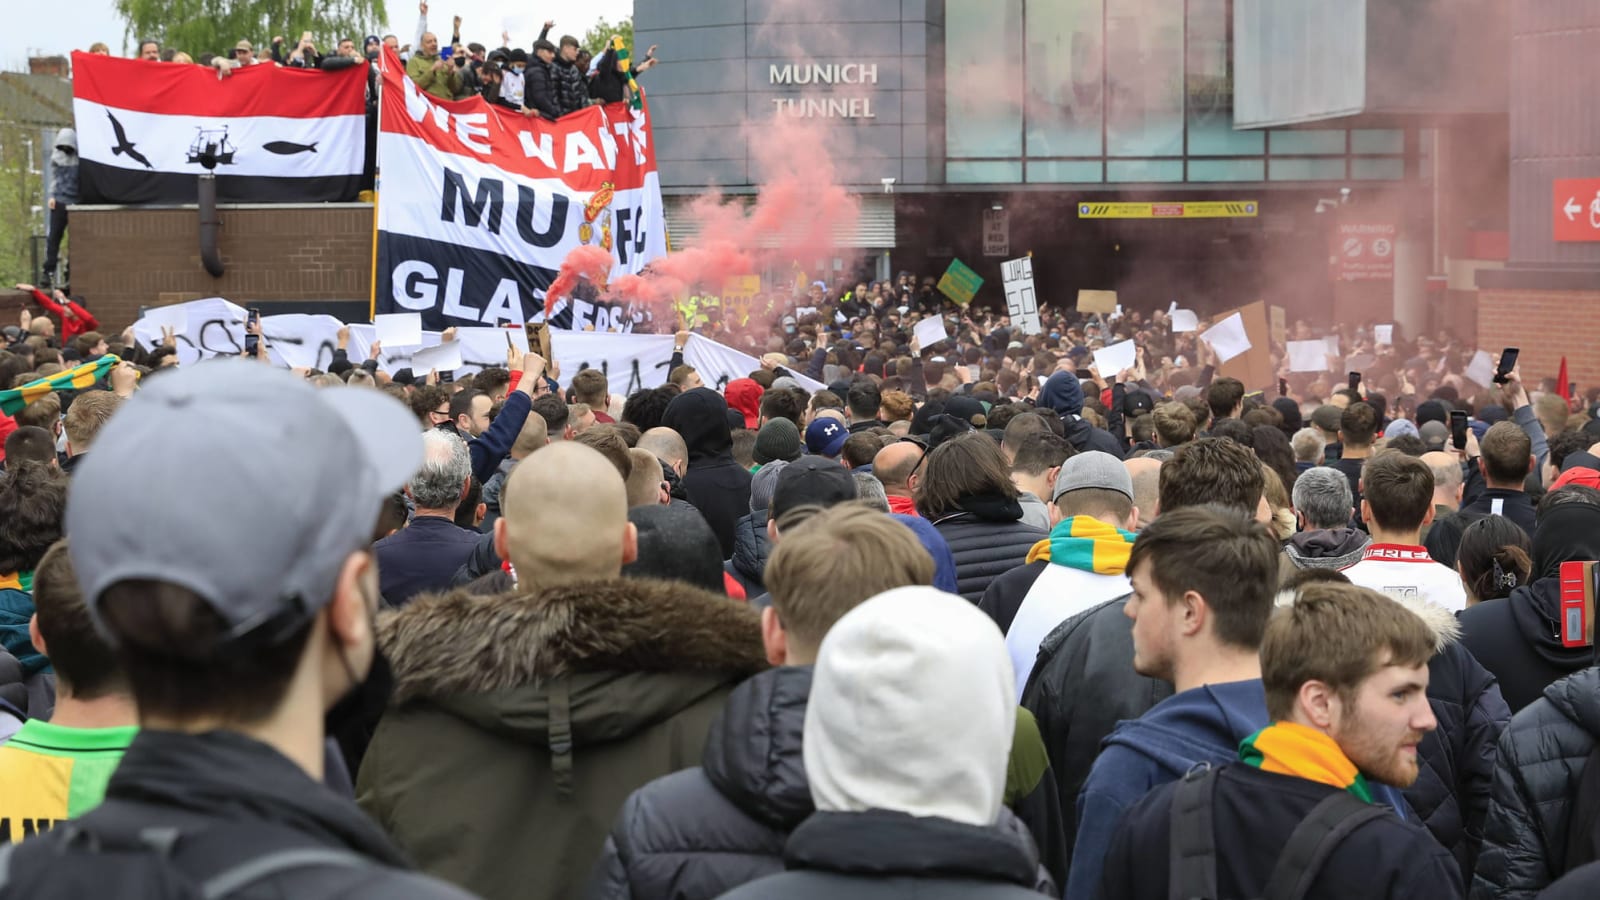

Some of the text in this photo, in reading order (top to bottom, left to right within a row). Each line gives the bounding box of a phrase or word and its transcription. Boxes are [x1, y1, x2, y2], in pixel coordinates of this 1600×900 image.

[769, 63, 878, 84] MUNICH
[402, 74, 492, 155] WE
[771, 97, 876, 118] TUNNEL
